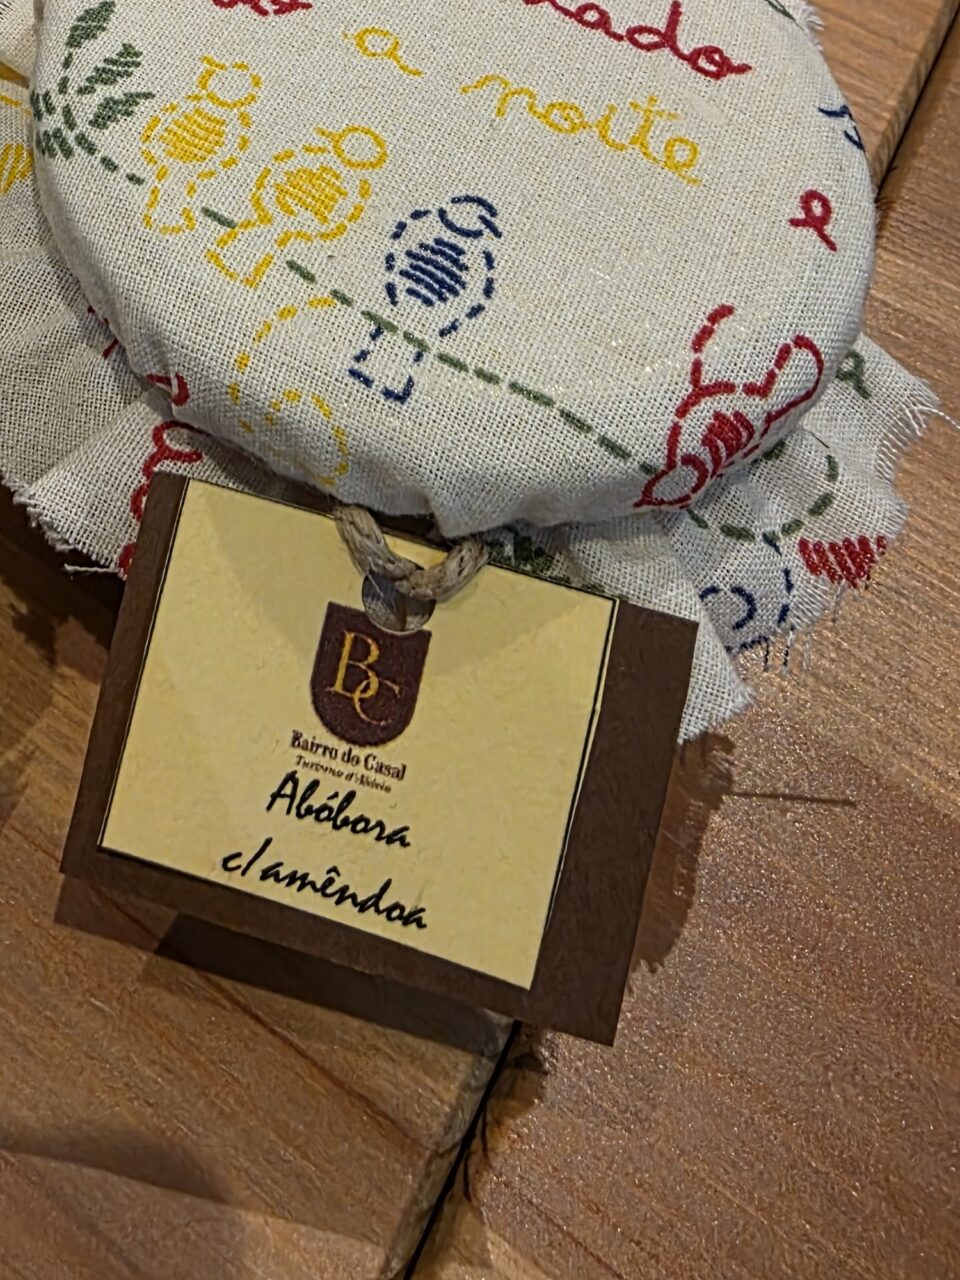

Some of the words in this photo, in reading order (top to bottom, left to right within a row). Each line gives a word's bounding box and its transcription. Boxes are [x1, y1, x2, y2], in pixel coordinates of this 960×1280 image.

[342, 26, 423, 77] a
[459, 73, 702, 187] noite
[291, 729, 338, 761] Bairro
[341, 746, 360, 767] do
[363, 752, 407, 781] Casal
[265, 770, 411, 848] Abóbora
